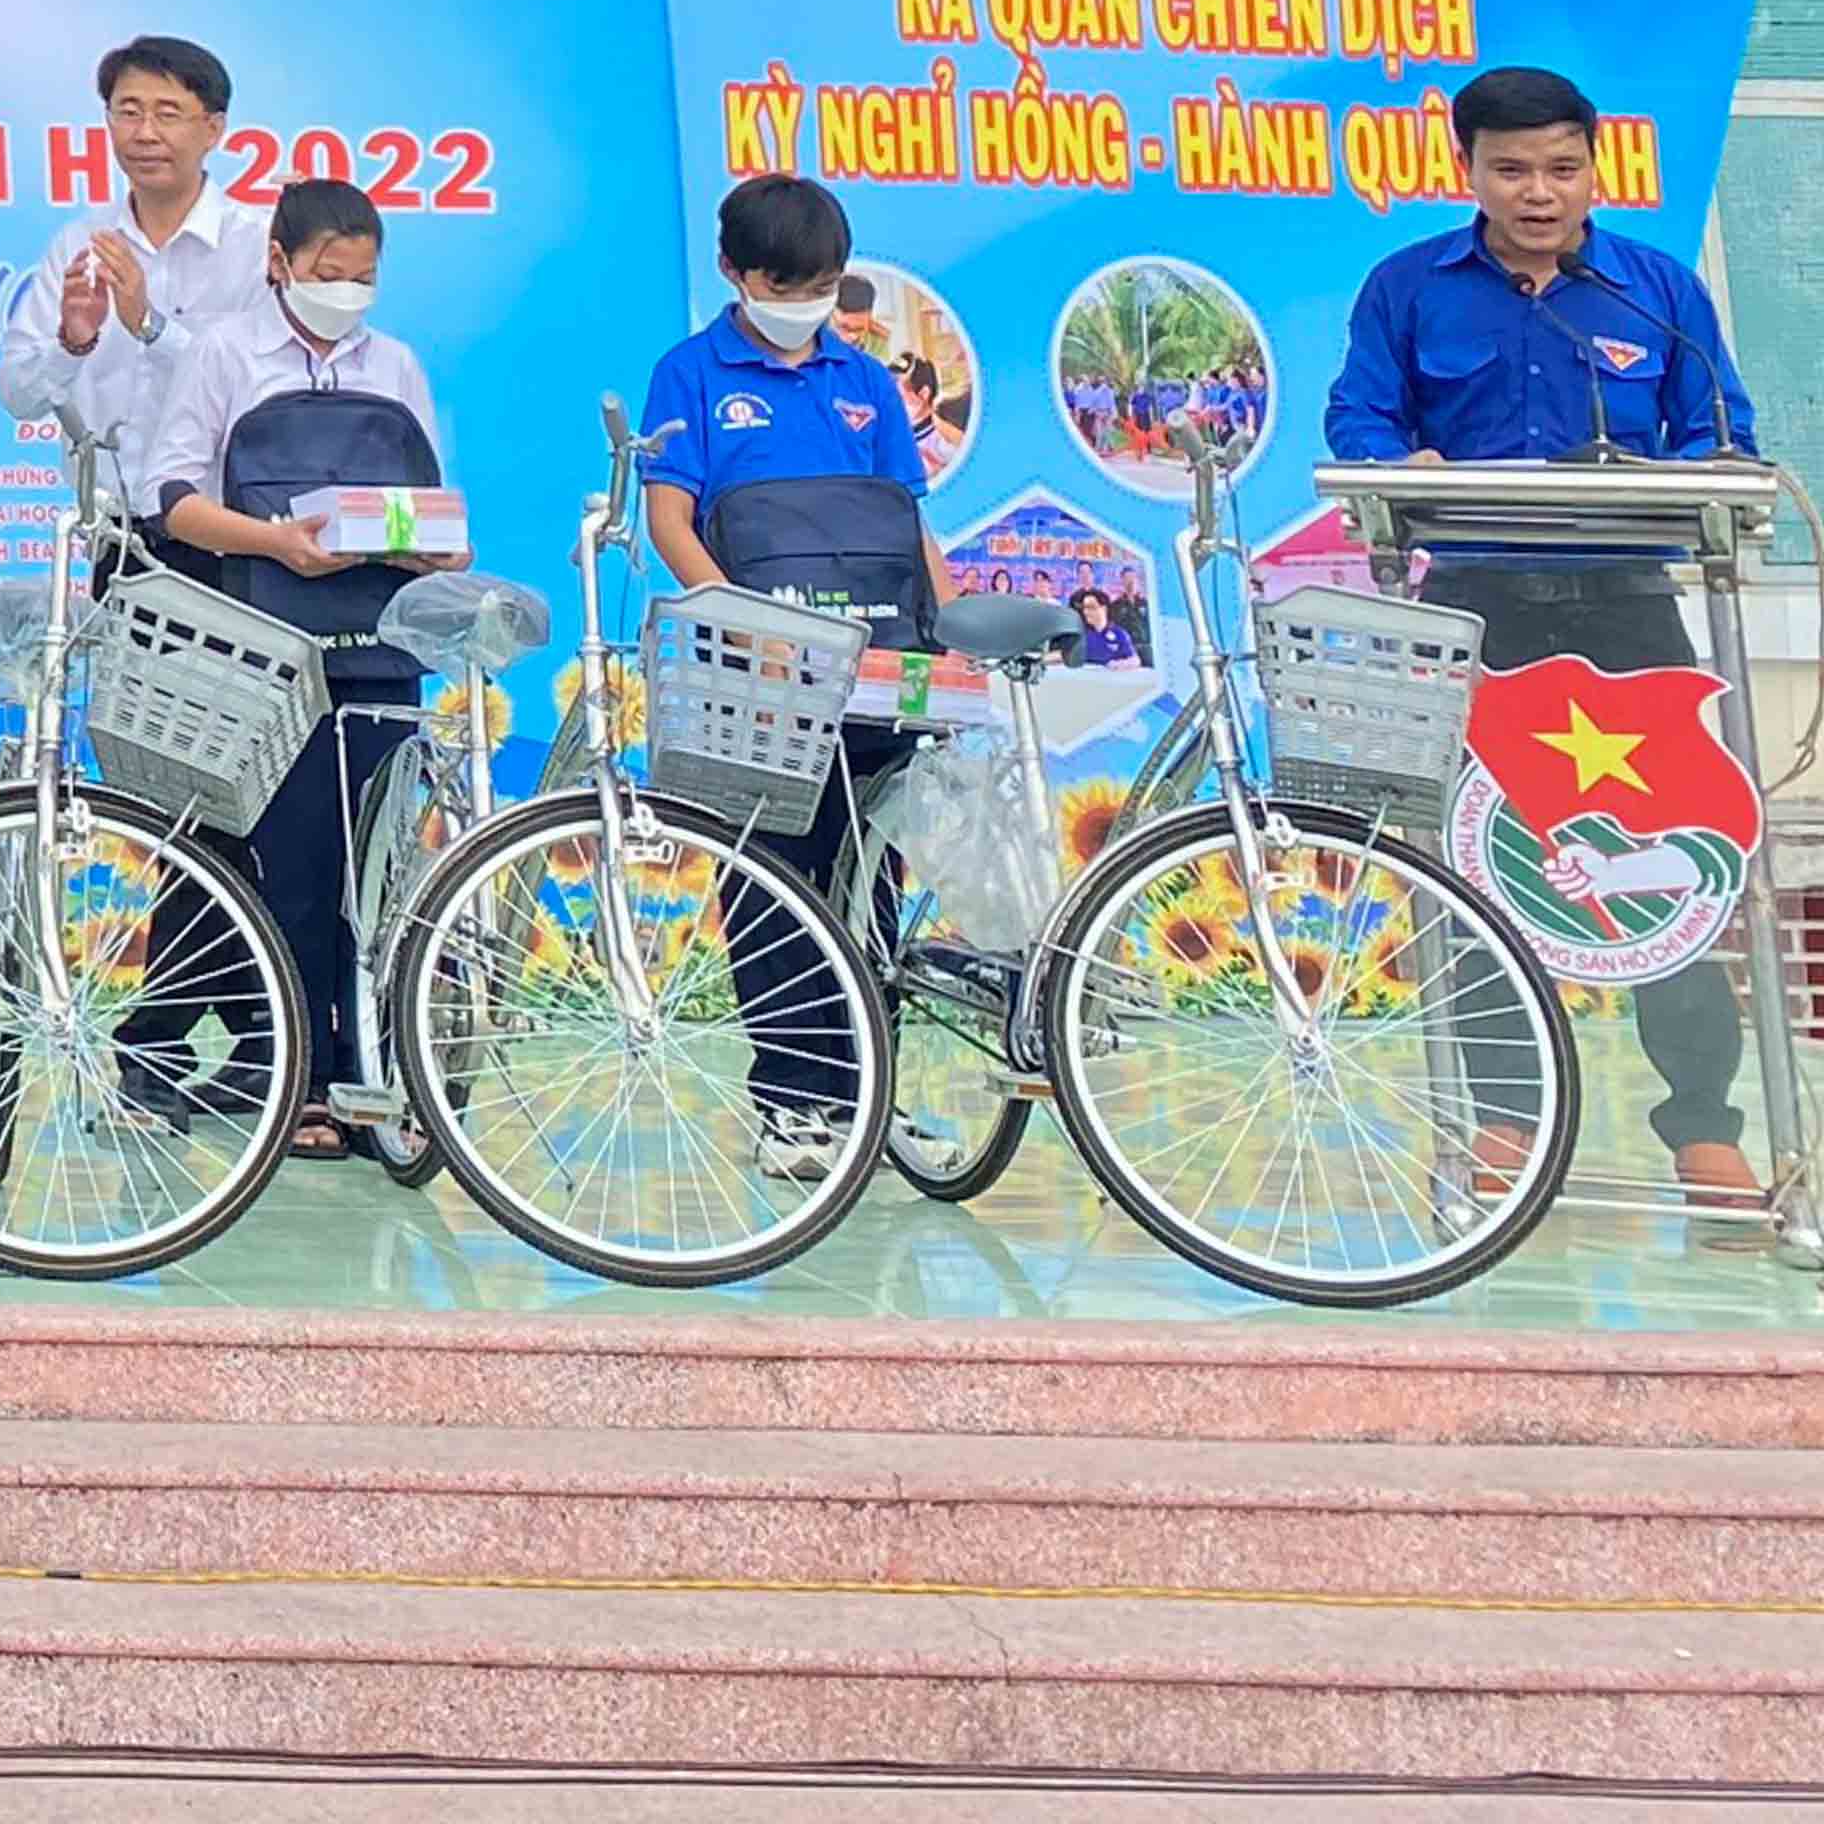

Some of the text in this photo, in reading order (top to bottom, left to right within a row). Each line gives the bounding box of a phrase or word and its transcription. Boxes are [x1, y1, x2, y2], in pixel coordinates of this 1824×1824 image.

[223, 129, 494, 209] 2022
[723, 62, 804, 175] KỲ
[817, 59, 958, 182] NGHỈ
[971, 54, 1131, 191] HỒNG
[1172, 77, 1331, 199] HÀNH
[1344, 88, 1474, 212] QUÂ
